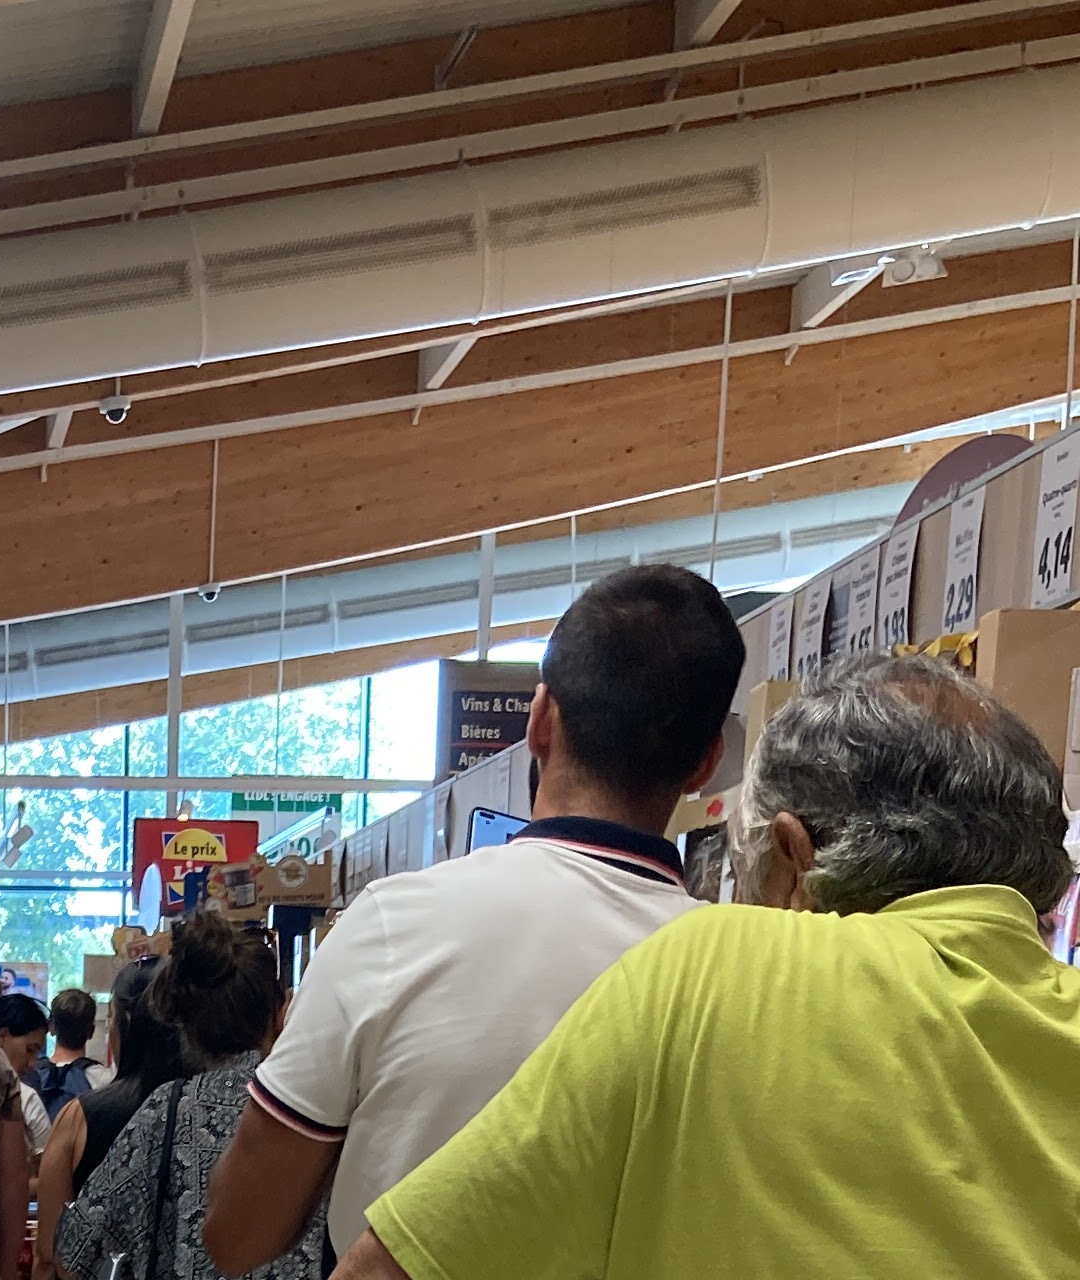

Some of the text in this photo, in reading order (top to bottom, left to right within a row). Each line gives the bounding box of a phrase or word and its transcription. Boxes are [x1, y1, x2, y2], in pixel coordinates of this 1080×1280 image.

[1037, 526, 1073, 590] 4,14
[943, 573, 974, 633] 2,29
[461, 697, 489, 713] Vins
[492, 697, 502, 713] &
[461, 723, 501, 739] Bières
[174, 841, 217, 858] Le prix
